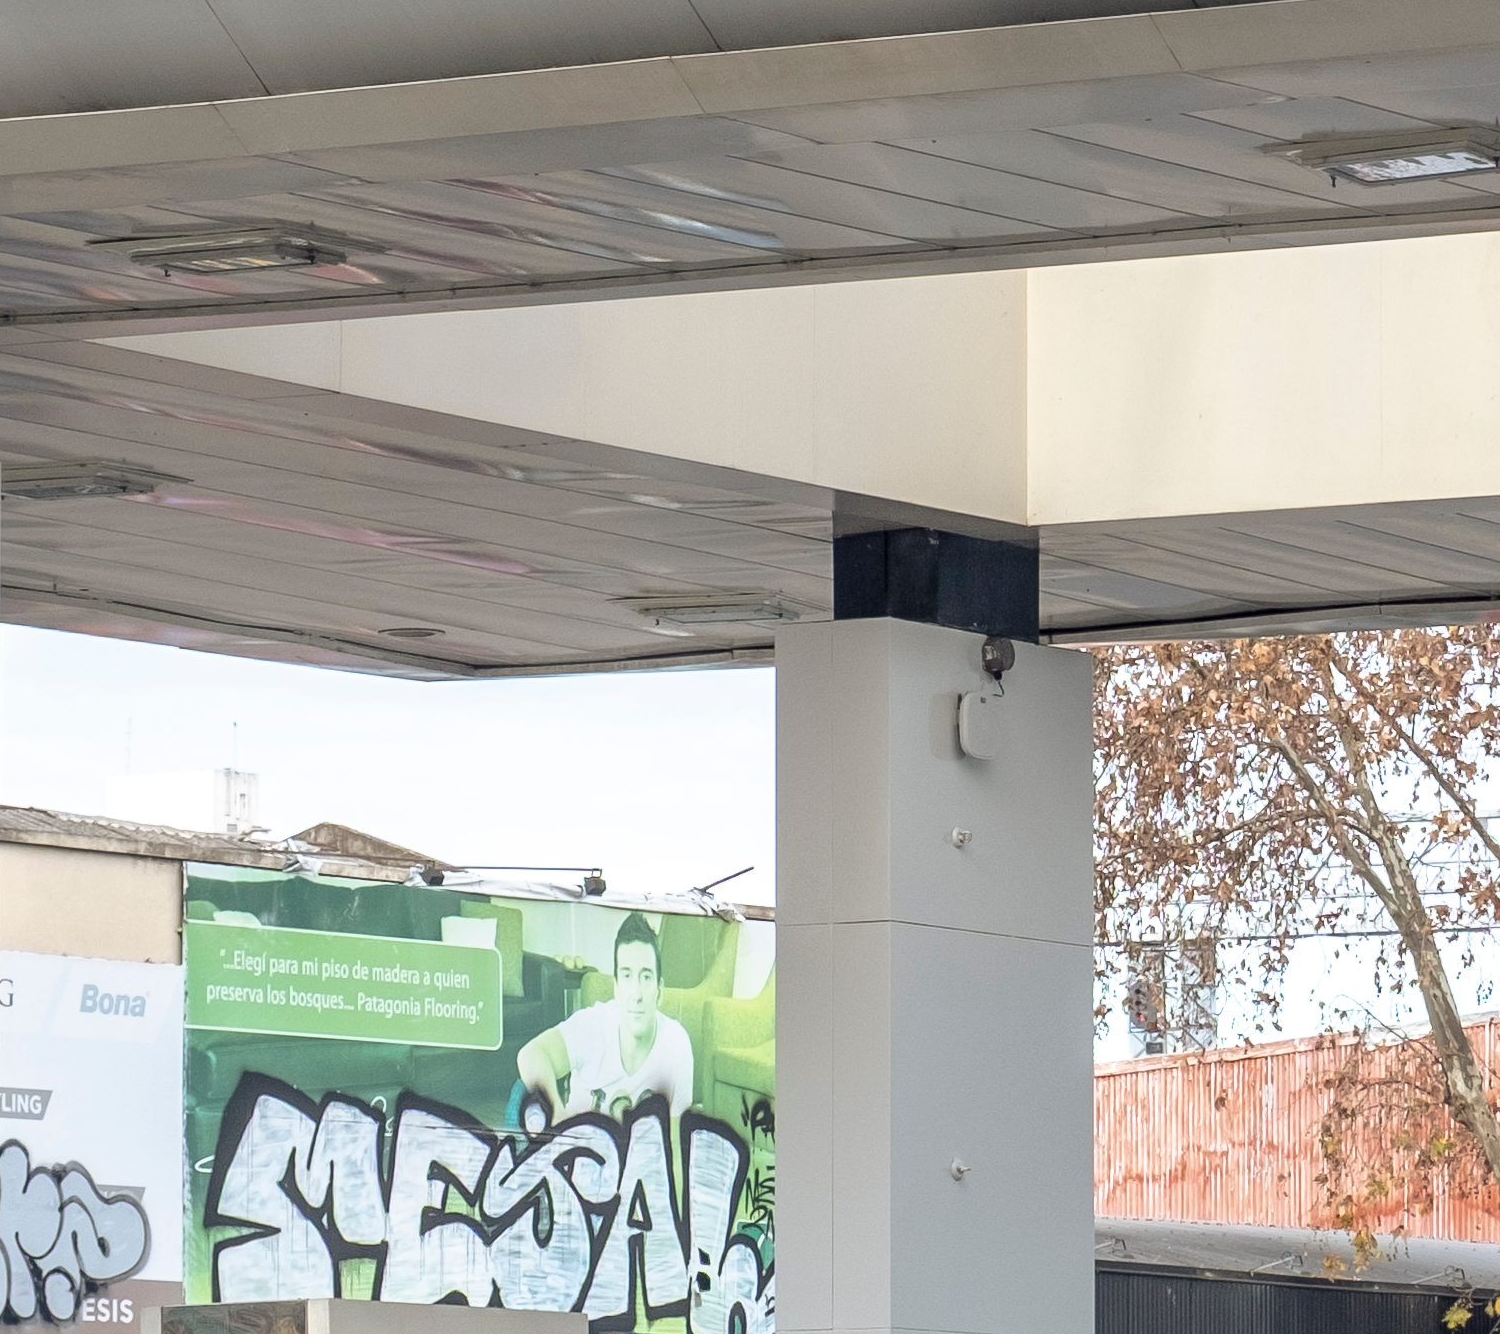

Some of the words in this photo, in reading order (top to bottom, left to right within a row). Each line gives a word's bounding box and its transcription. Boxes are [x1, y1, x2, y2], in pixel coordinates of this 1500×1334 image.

[269, 955, 298, 976] para
[302, 959, 318, 976] mi
[322, 960, 349, 981] piso
[352, 960, 369, 979] de
[372, 963, 420, 984] madera
[424, 969, 431, 984] a
[434, 968, 470, 990] quien
[79, 983, 147, 1018] Bona
[206, 984, 263, 1004] preserva
[267, 984, 286, 1006] los
[357, 992, 421, 1019] Patagonia
